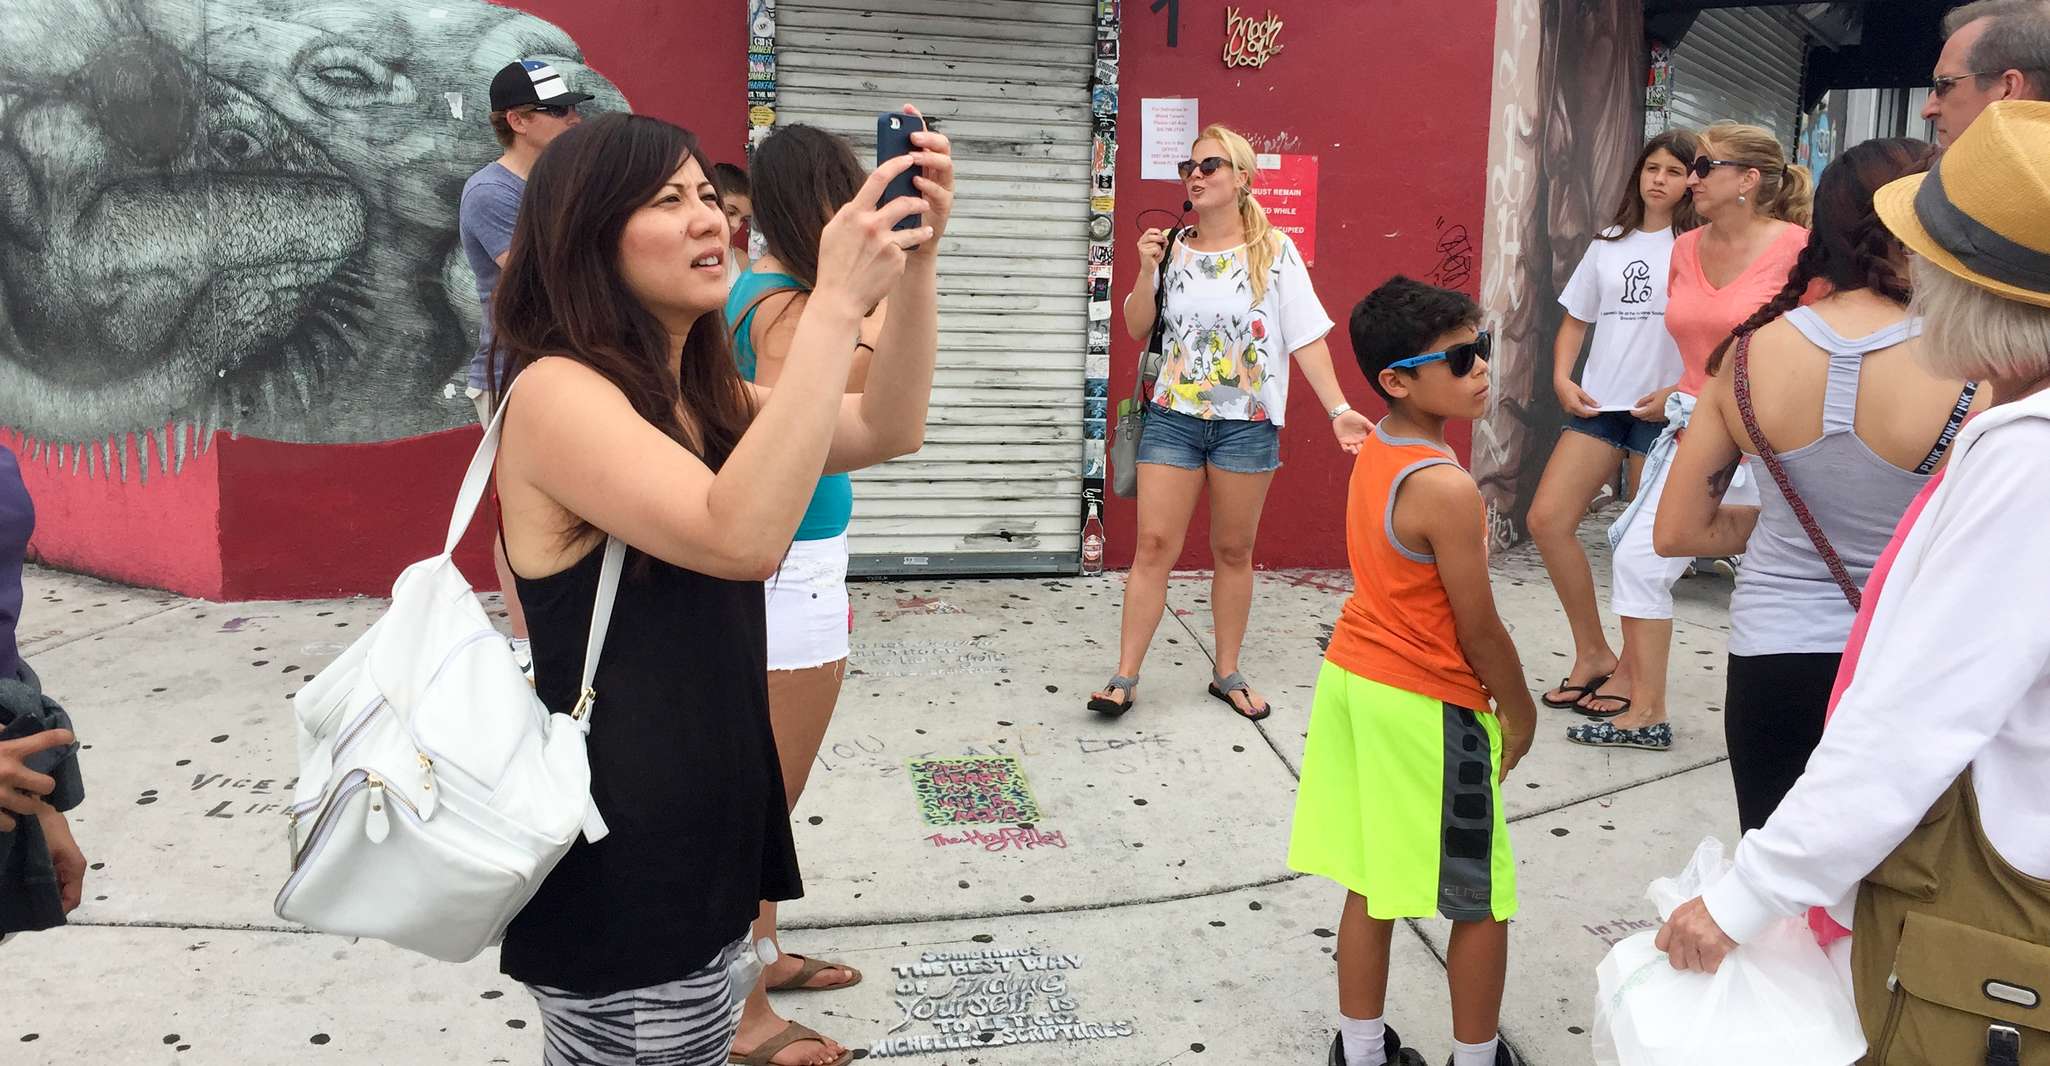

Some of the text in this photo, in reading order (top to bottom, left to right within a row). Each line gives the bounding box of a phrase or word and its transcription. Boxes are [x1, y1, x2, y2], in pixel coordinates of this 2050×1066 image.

[1251, 188, 1302, 197] MUST REMAIN
[1273, 207, 1297, 216] WHILE
[1920, 447, 1944, 473] PINK
[1939, 419, 1960, 447] PINK
[191, 773, 276, 791] VICE
[892, 953, 1084, 979] THE BEST WAY
[895, 980, 928, 996] OF
[933, 1018, 972, 1035] TO
[976, 1012, 1029, 1031] LET
